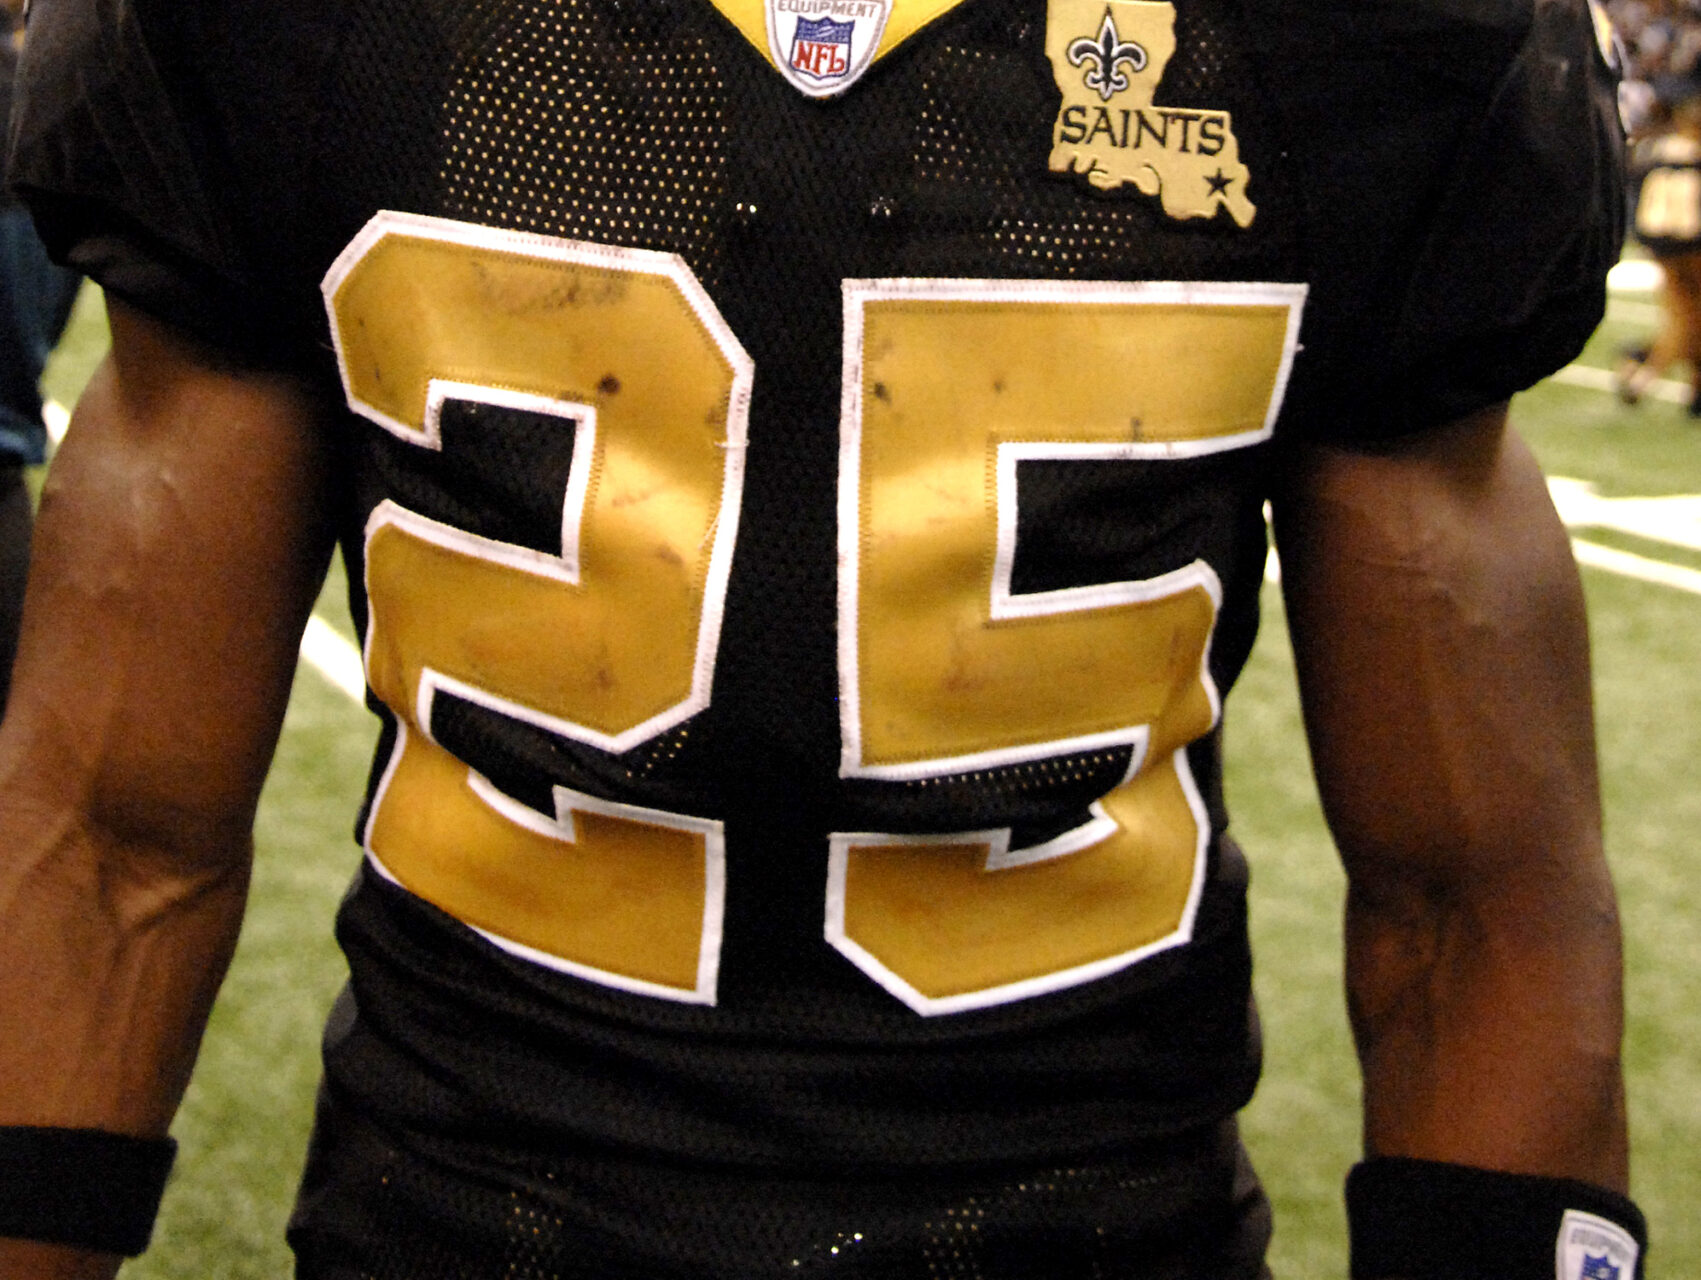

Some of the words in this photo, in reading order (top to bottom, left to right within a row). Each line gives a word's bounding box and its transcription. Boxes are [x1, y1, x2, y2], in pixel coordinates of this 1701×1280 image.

[793, 40, 845, 75] NFL
[1060, 105, 1226, 157] SAINTS
[321, 210, 1310, 1017] 25
